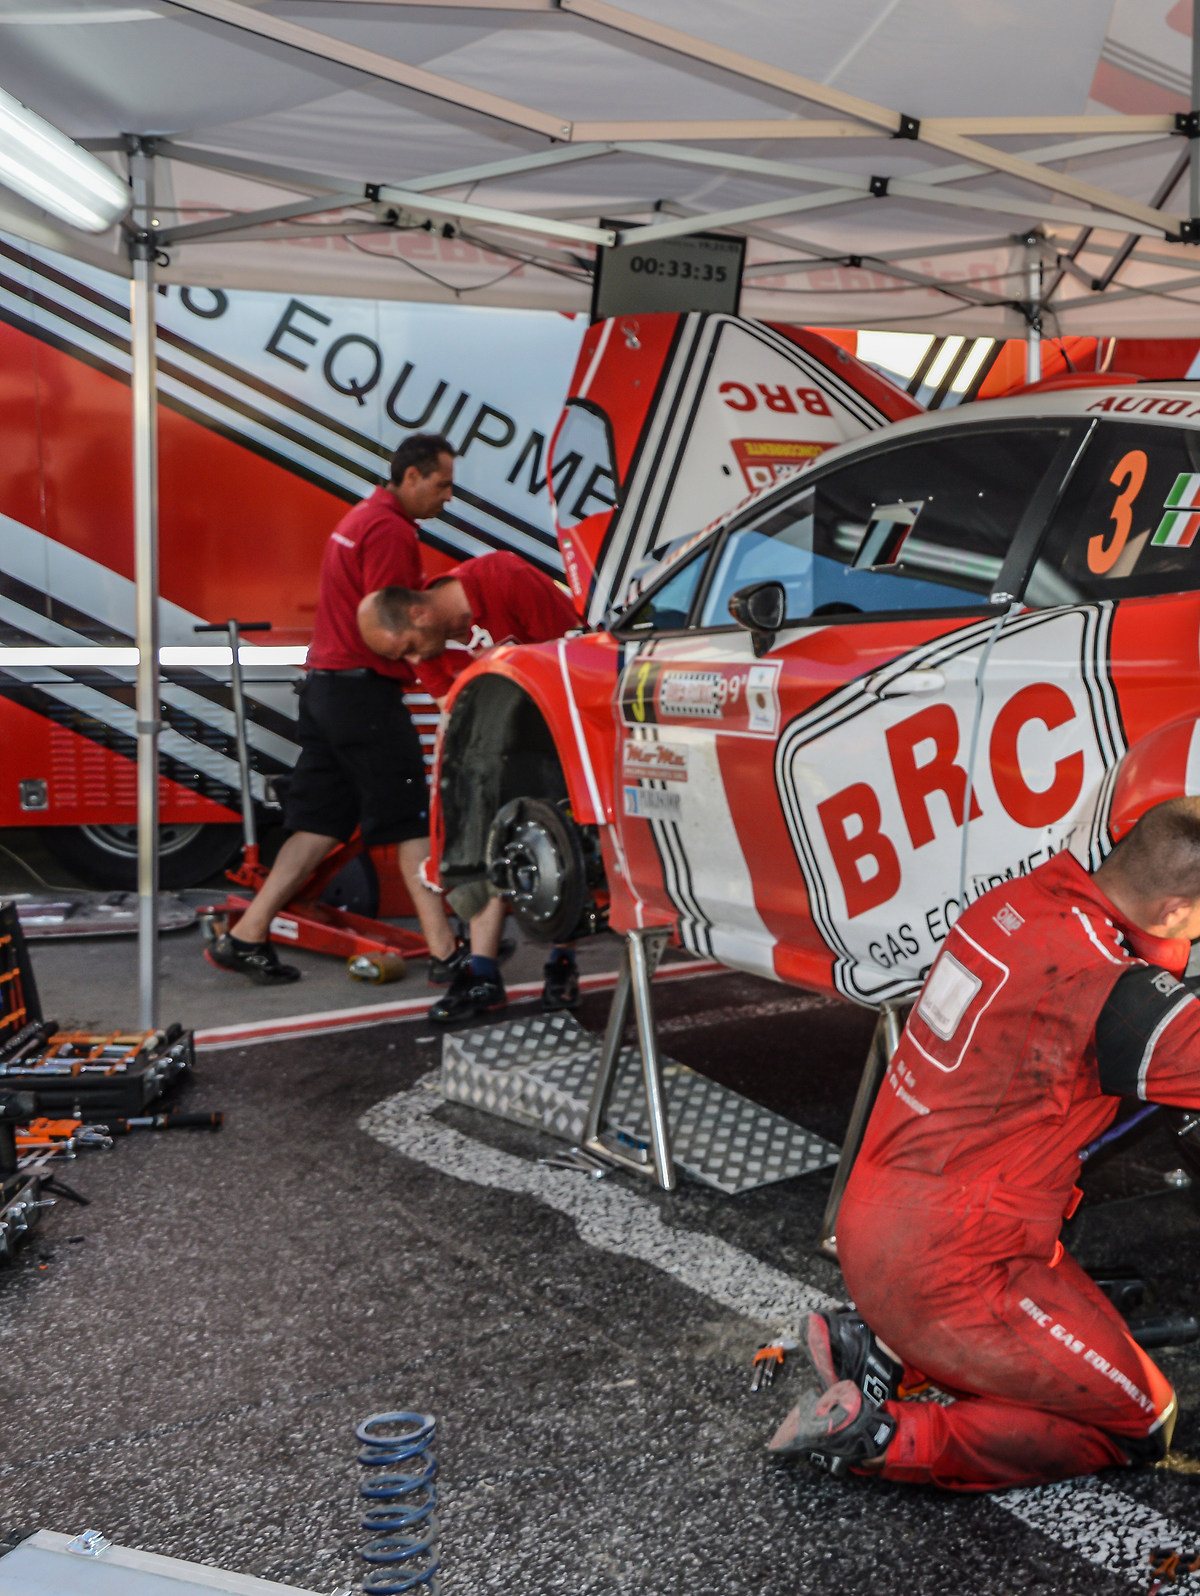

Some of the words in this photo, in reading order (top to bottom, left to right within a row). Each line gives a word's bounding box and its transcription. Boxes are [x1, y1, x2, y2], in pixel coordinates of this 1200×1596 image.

[630, 255, 728, 283] 00:33:35
[718, 381, 834, 418] BRC
[1086, 396, 1192, 416] AUTO
[1087, 449, 1148, 575] 3
[817, 682, 1085, 920] BRC
[868, 923, 920, 969] GAS
